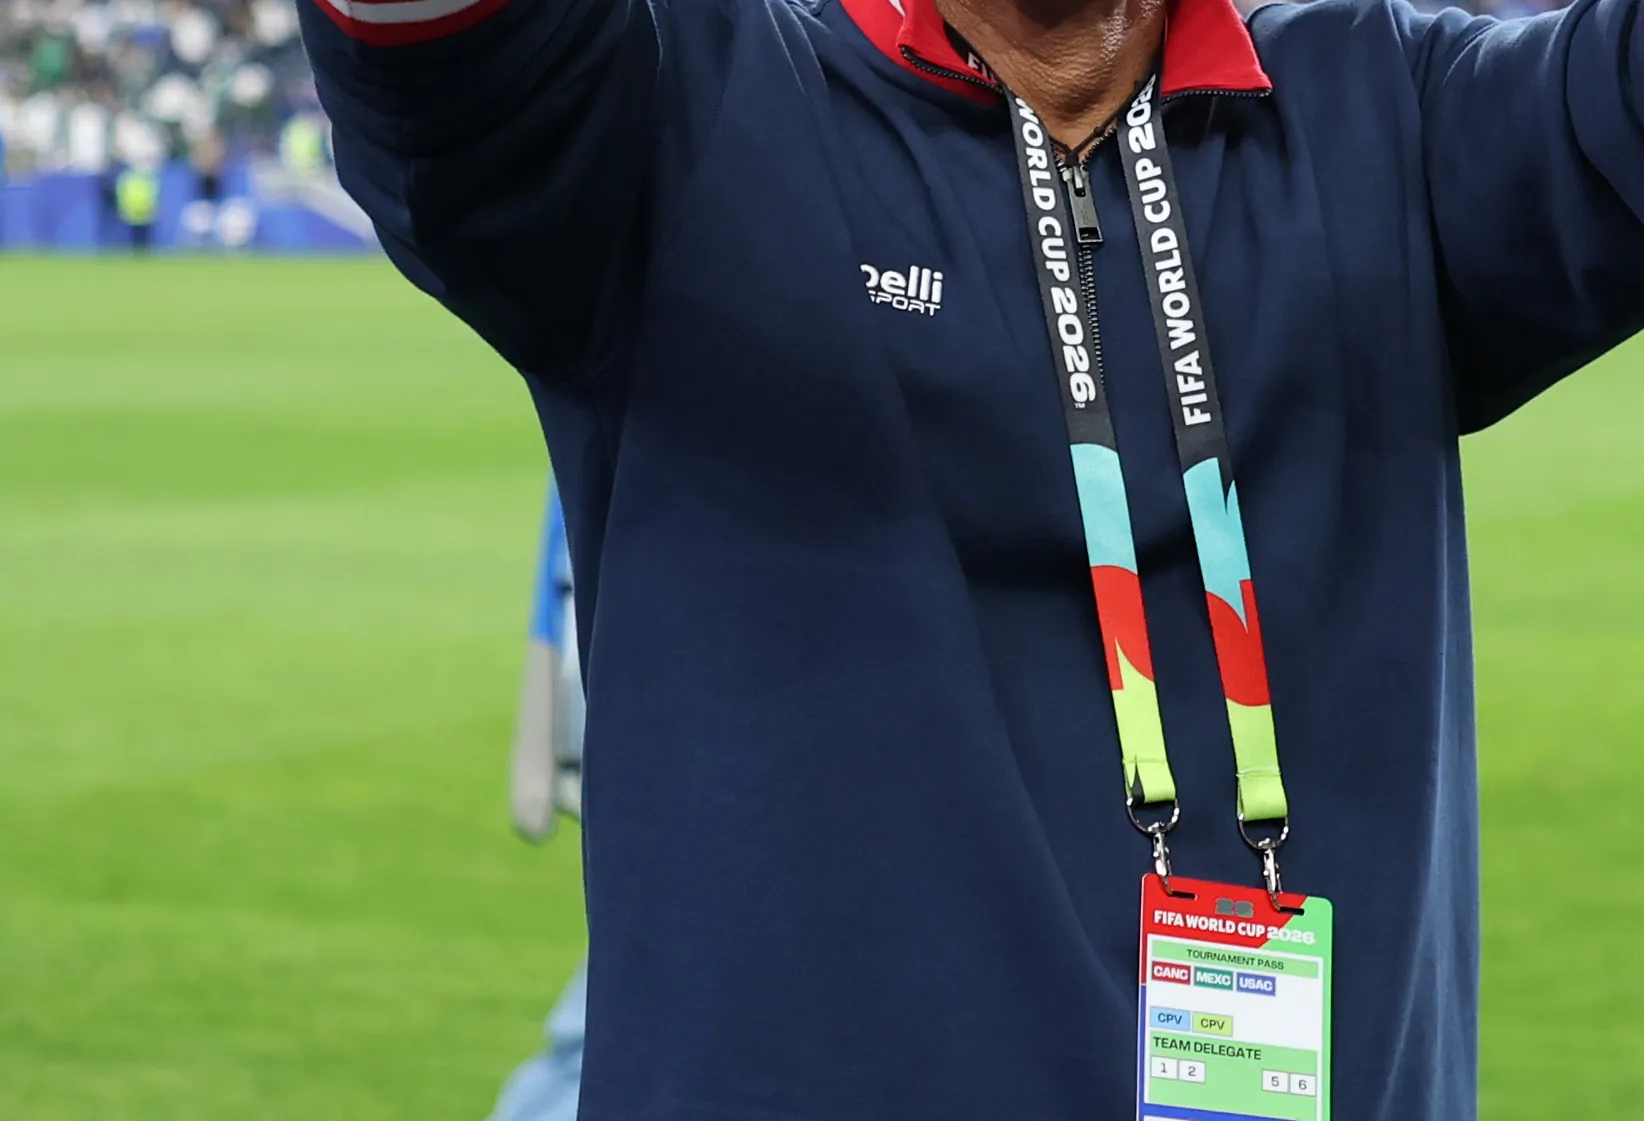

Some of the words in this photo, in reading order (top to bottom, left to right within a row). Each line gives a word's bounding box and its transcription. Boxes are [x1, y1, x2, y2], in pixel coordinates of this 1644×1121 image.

[1135, 157, 1171, 223] CUP
[1038, 216, 1071, 282] CUP
[1150, 227, 1197, 351] WORLD
[1051, 286, 1096, 401] 2026
[1174, 349, 1212, 426] FIFA
[1153, 909, 1184, 927] FIFA
[1185, 914, 1236, 934] WORLD
[1237, 922, 1266, 937] CUP
[1266, 926, 1316, 944] 2026
[1187, 948, 1255, 967] TOURNAMENT
[1257, 958, 1284, 970] PASS
[1153, 965, 1188, 980] CANC
[1196, 971, 1231, 986] MEXC
[1239, 977, 1273, 992] USAC
[1157, 1012, 1182, 1025] CPV
[1200, 1018, 1225, 1030] CPV
[1153, 1036, 1191, 1052] TEAM
[1193, 1041, 1262, 1060] DELEGATE
[1160, 1062, 1168, 1074] 1
[1188, 1066, 1196, 1077] 2
[1271, 1076, 1279, 1087] 5
[1298, 1079, 1307, 1090] 6
